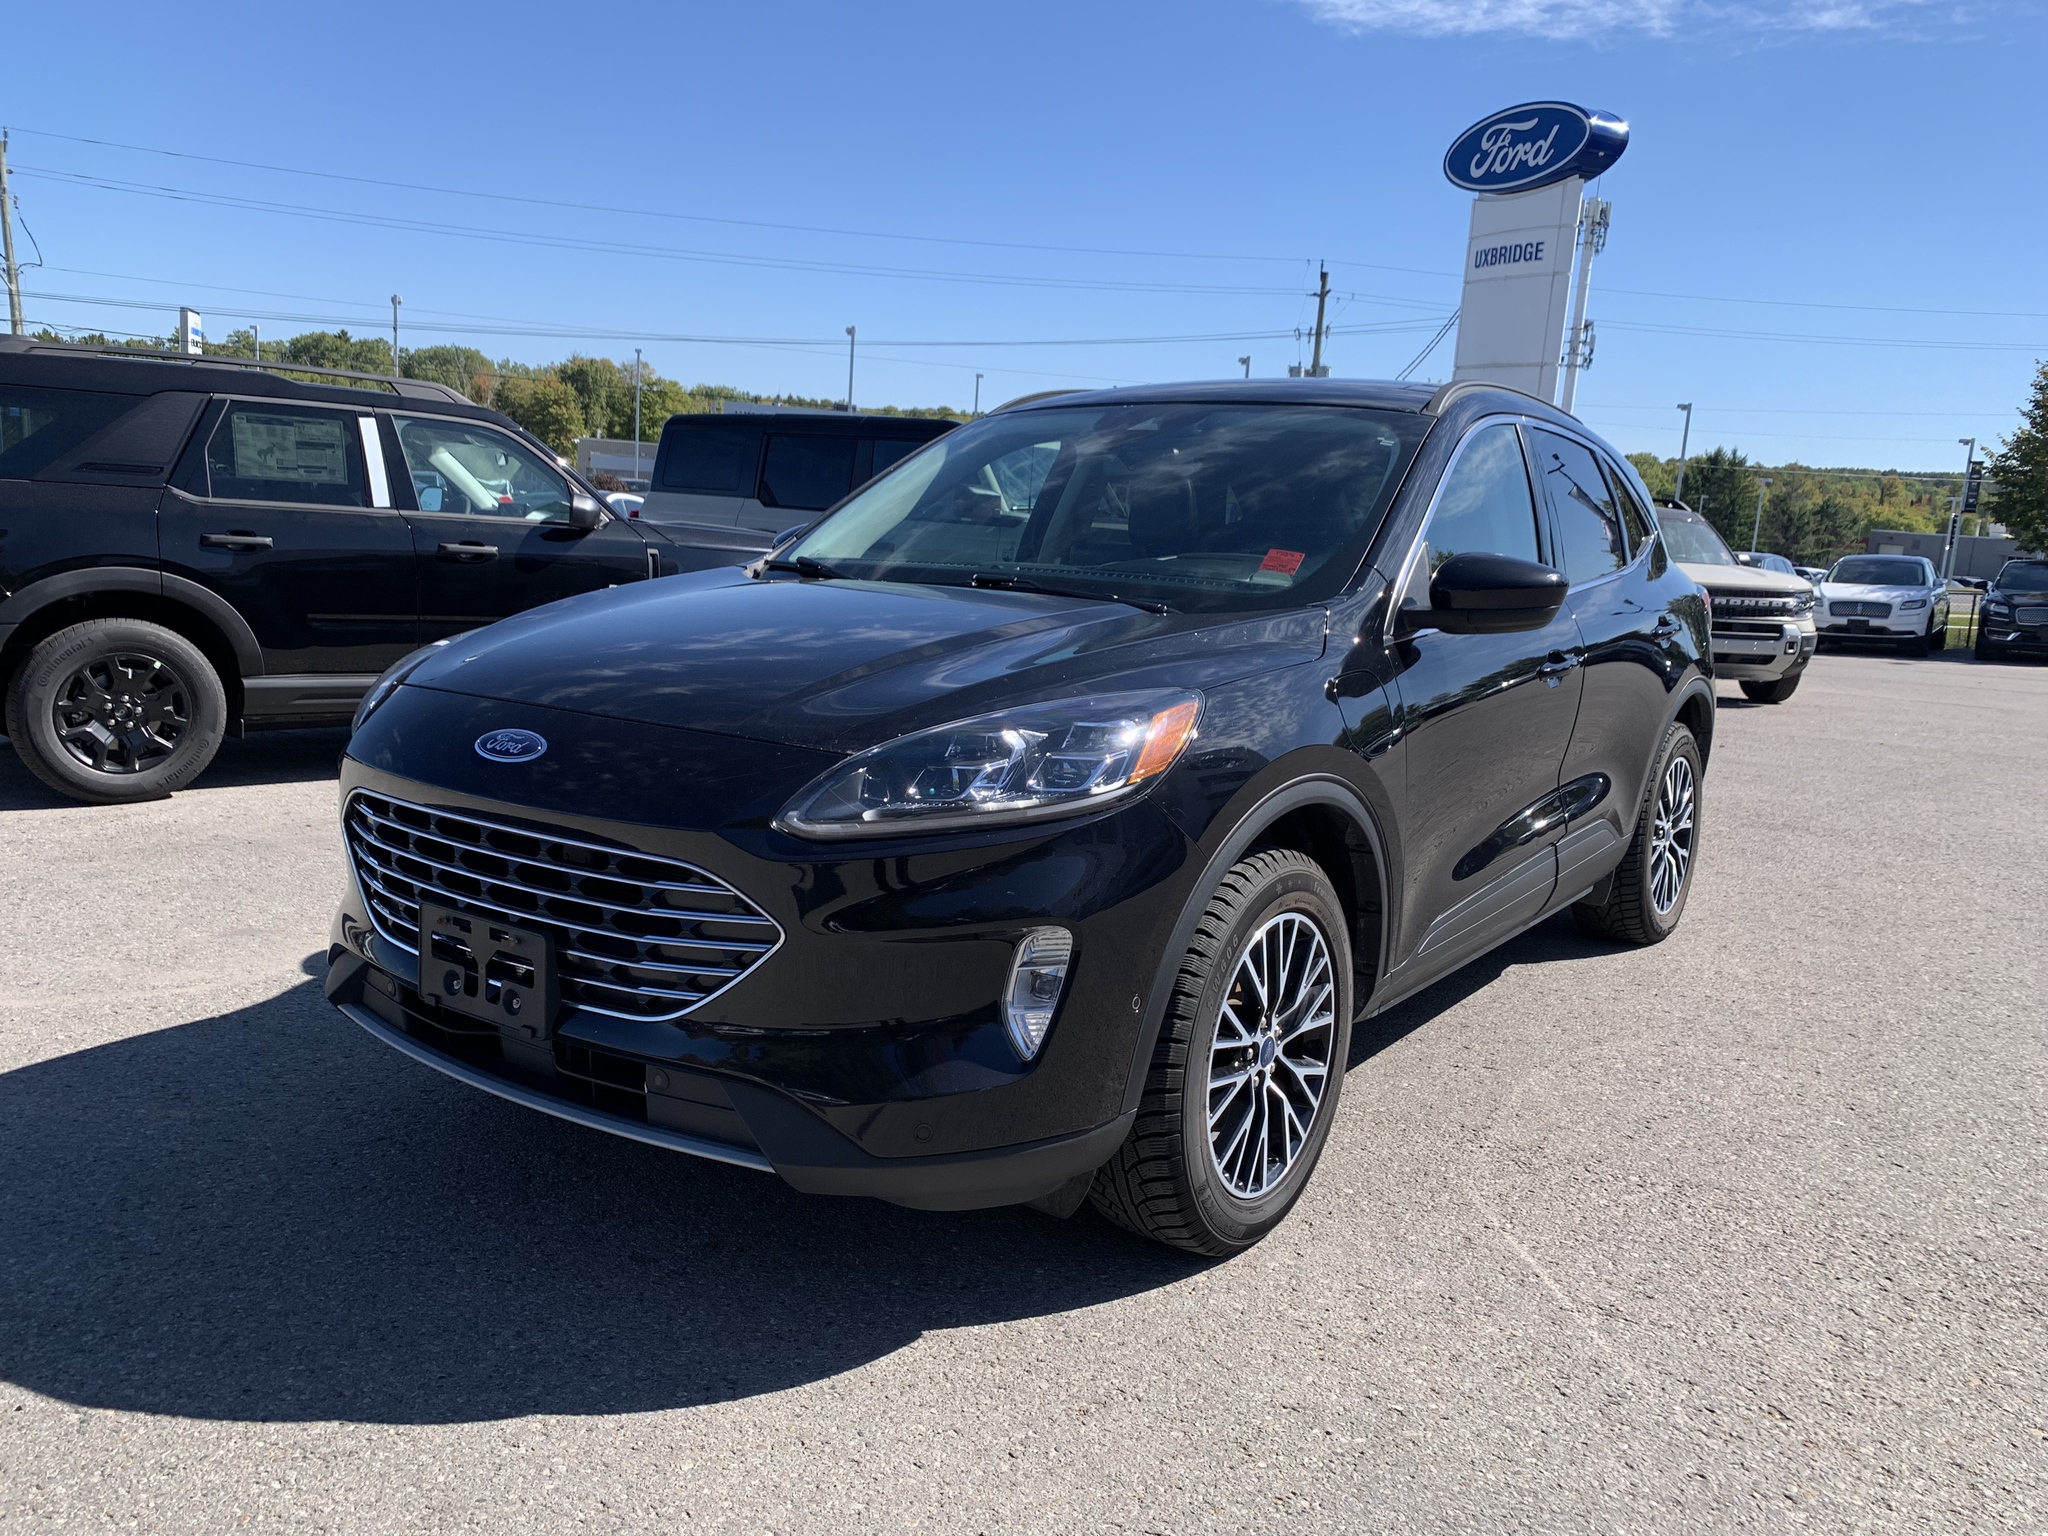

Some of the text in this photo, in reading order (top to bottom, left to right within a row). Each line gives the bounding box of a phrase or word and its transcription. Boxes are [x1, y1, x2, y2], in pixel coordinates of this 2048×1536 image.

[1470, 117, 1560, 178] Ford
[1475, 241, 1544, 269] UXBRIDGE
[37, 640, 86, 688] Continental
[487, 732, 530, 754] Ford
